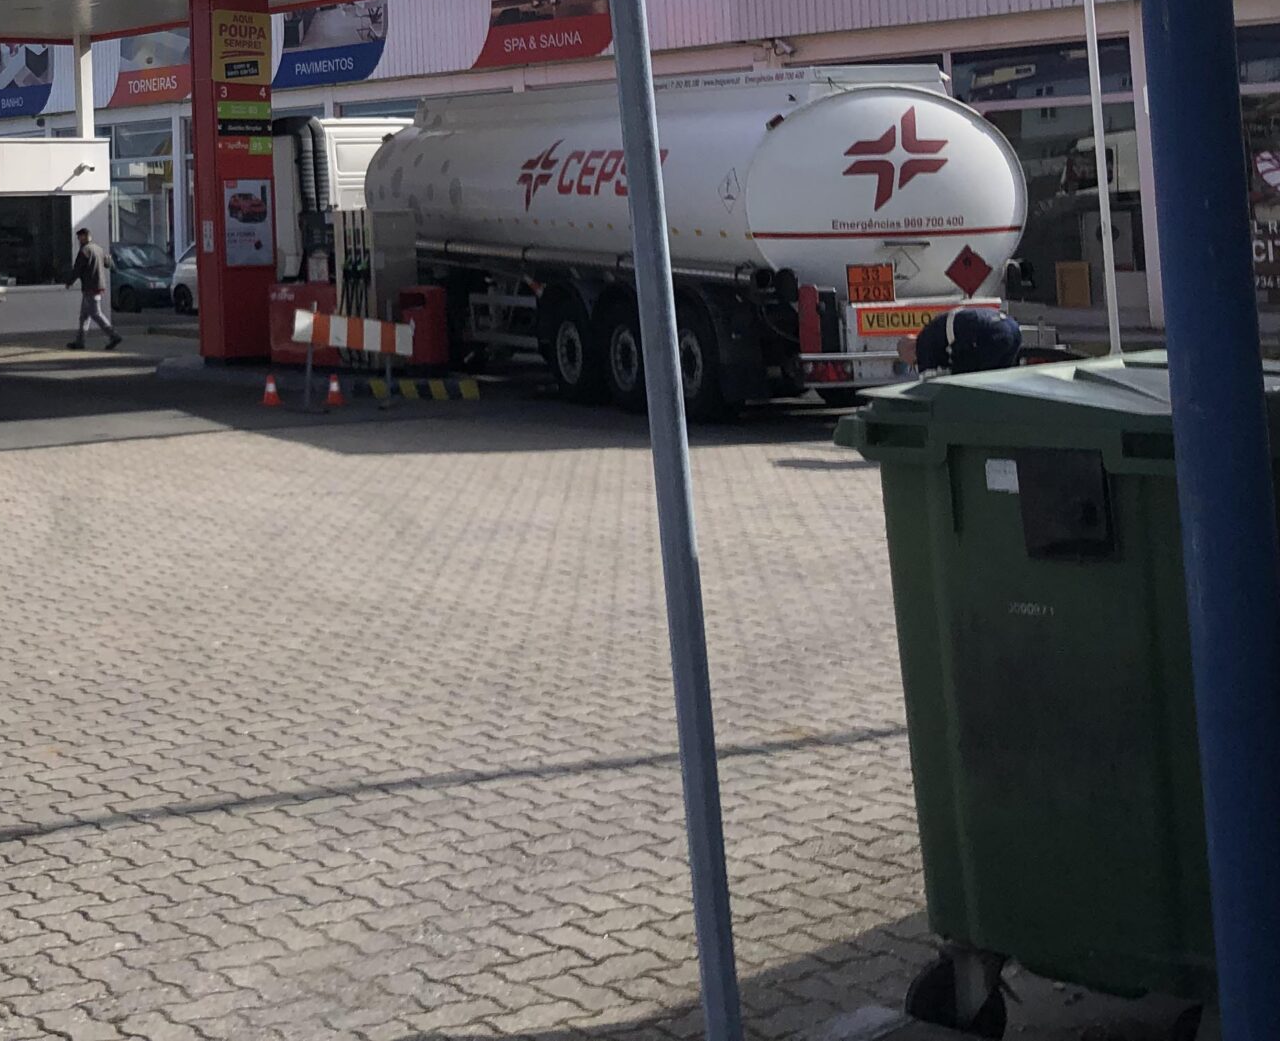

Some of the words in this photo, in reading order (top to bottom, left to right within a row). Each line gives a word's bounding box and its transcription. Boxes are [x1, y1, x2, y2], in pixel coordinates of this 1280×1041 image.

[232, 14, 254, 24] AQUI
[219, 24, 267, 40] POUPA
[503, 37, 527, 53] SPA
[528, 37, 537, 50] &
[538, 31, 583, 49] SAUNA
[295, 57, 354, 75] PAVIMENTOS
[128, 75, 178, 94] TORNEIRAS
[220, 87, 228, 98] 3
[258, 87, 267, 98] 4
[0, 97, 24, 109] BANHO
[558, 150, 669, 196] CEPS
[832, 219, 901, 232] Emergências
[862, 269, 880, 280] 33
